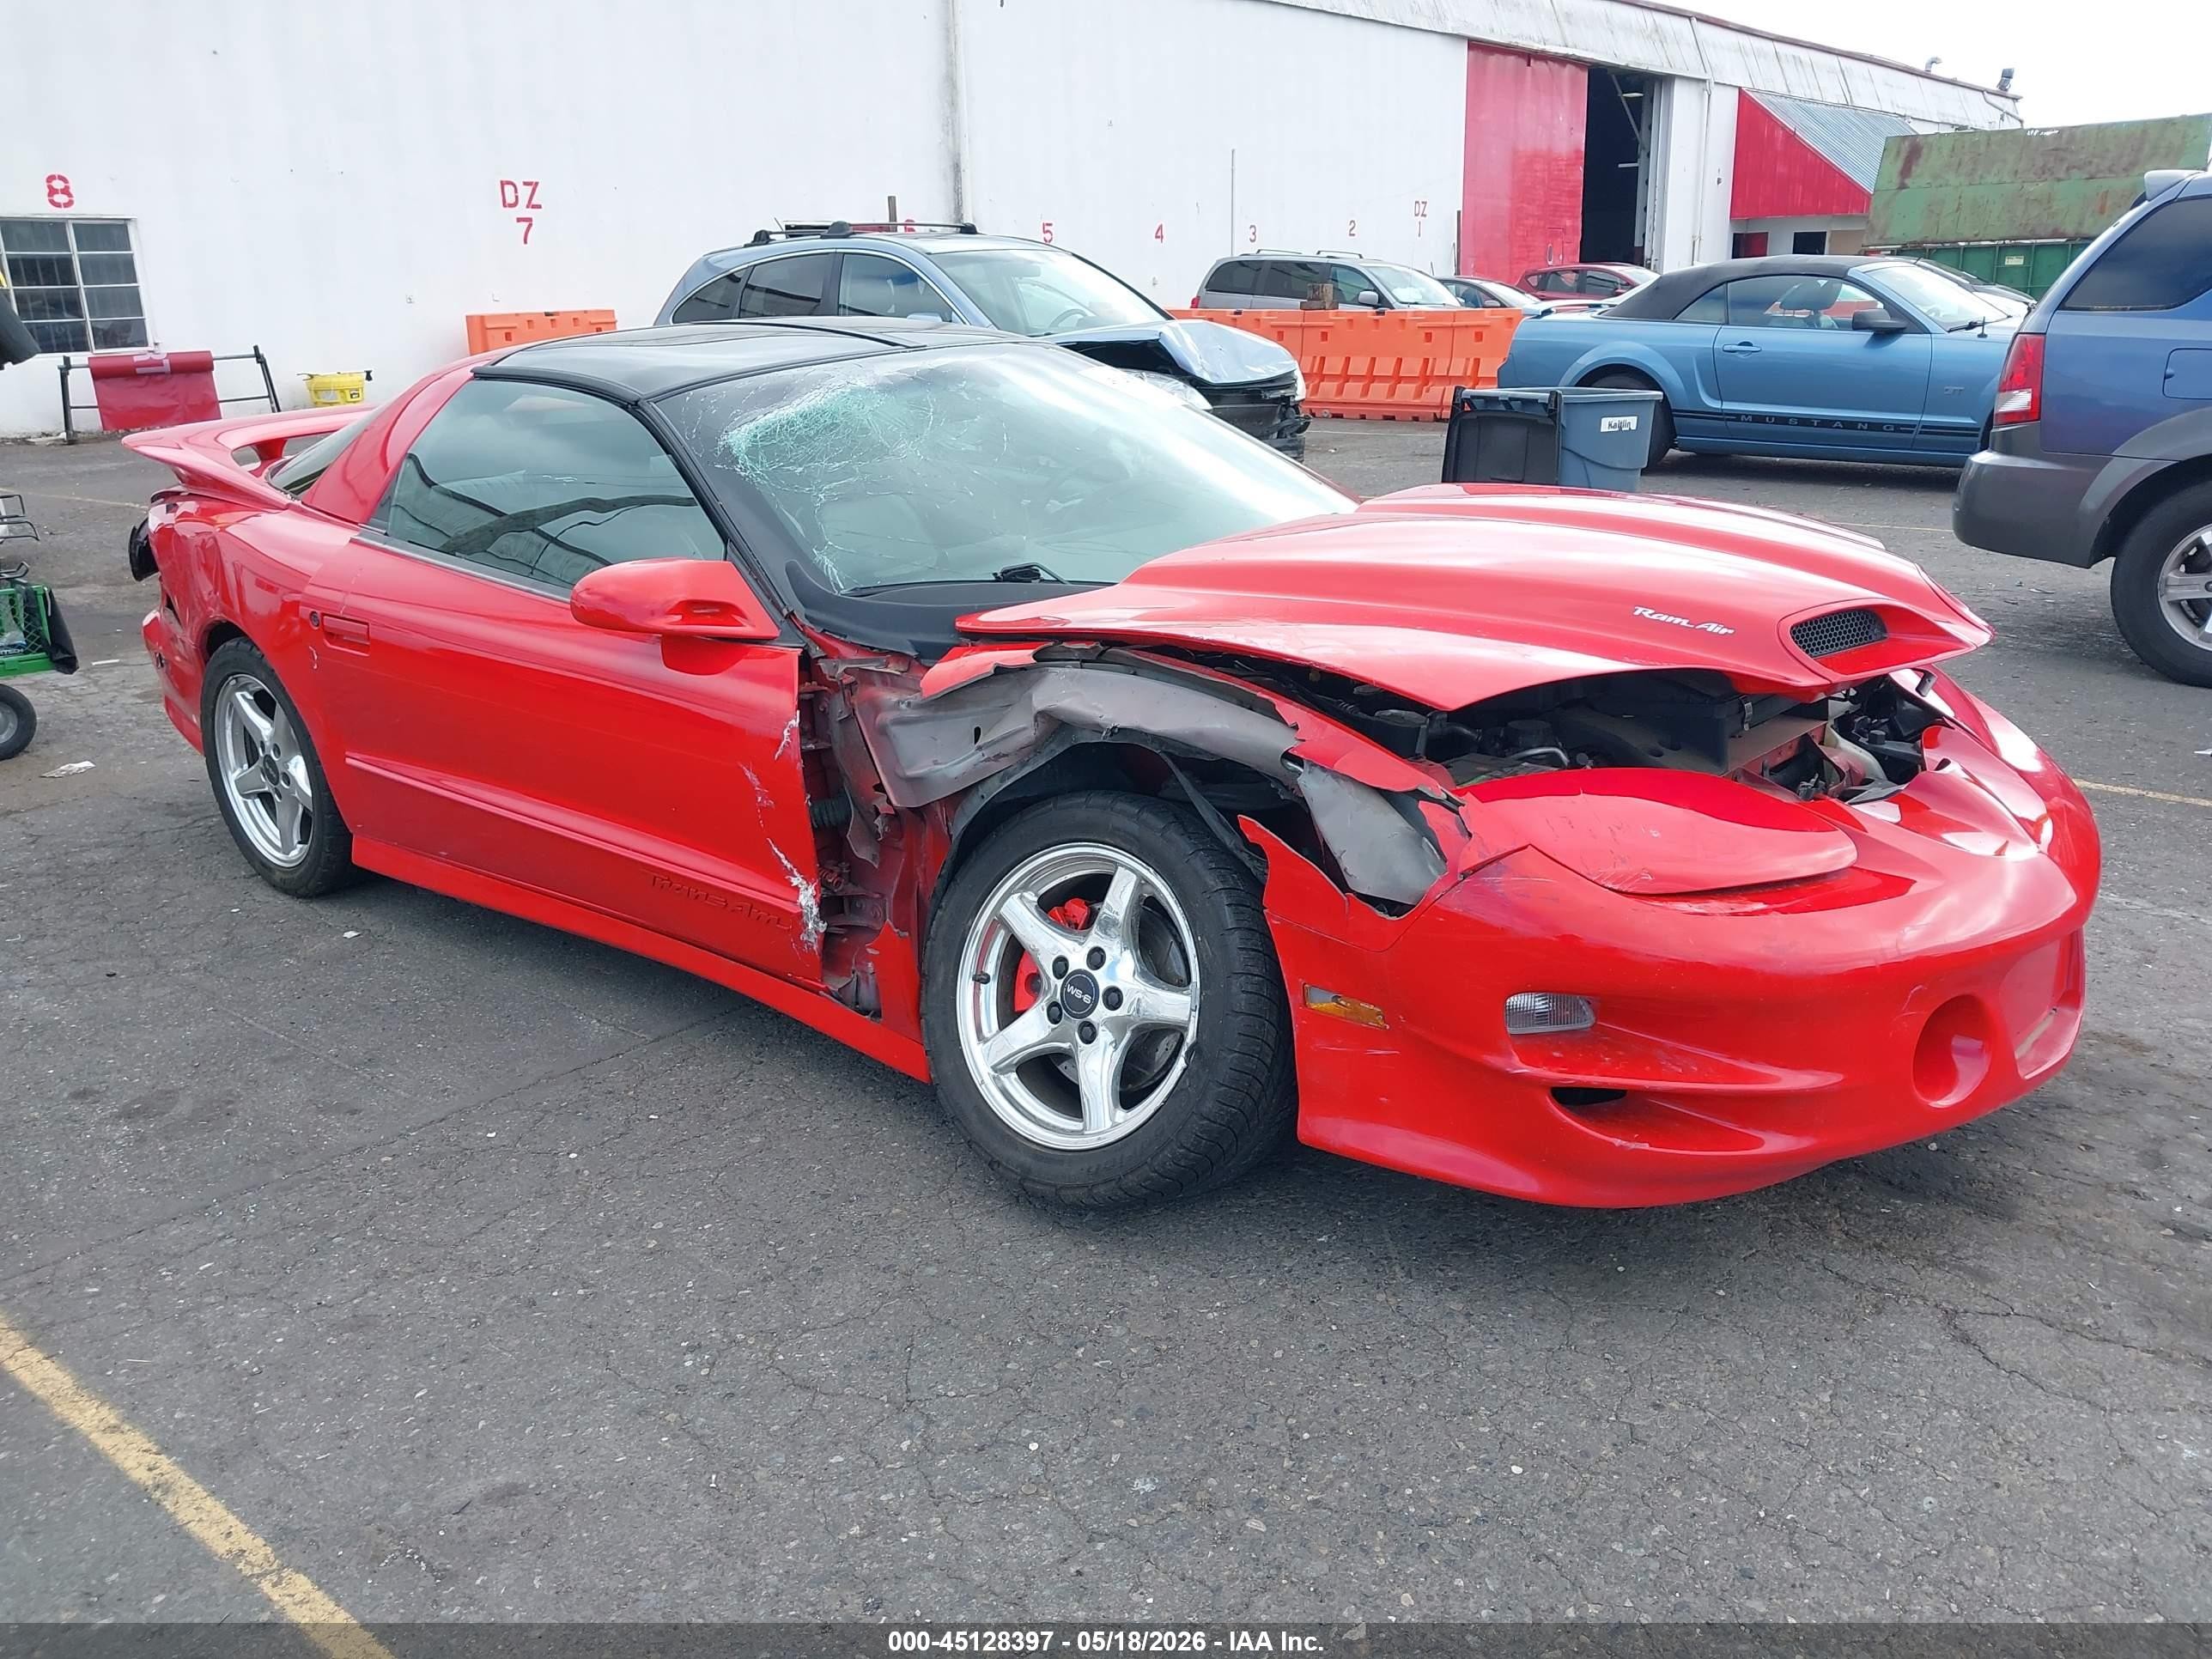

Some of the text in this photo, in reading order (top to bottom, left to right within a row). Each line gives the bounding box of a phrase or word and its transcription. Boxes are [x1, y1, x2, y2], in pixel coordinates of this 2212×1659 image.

[46, 174, 75, 209] 8
[500, 179, 543, 209] DZ
[1414, 200, 1427, 217] DZ
[516, 216, 533, 245] 7
[1042, 222, 1053, 243] 5
[1155, 223, 1164, 243] 4
[1249, 224, 1256, 243] 3
[1349, 219, 1356, 237] 2
[1418, 220, 1421, 238] 1
[1741, 414, 1895, 431] MUSTANG
[1633, 605, 1735, 635] Ram Air
